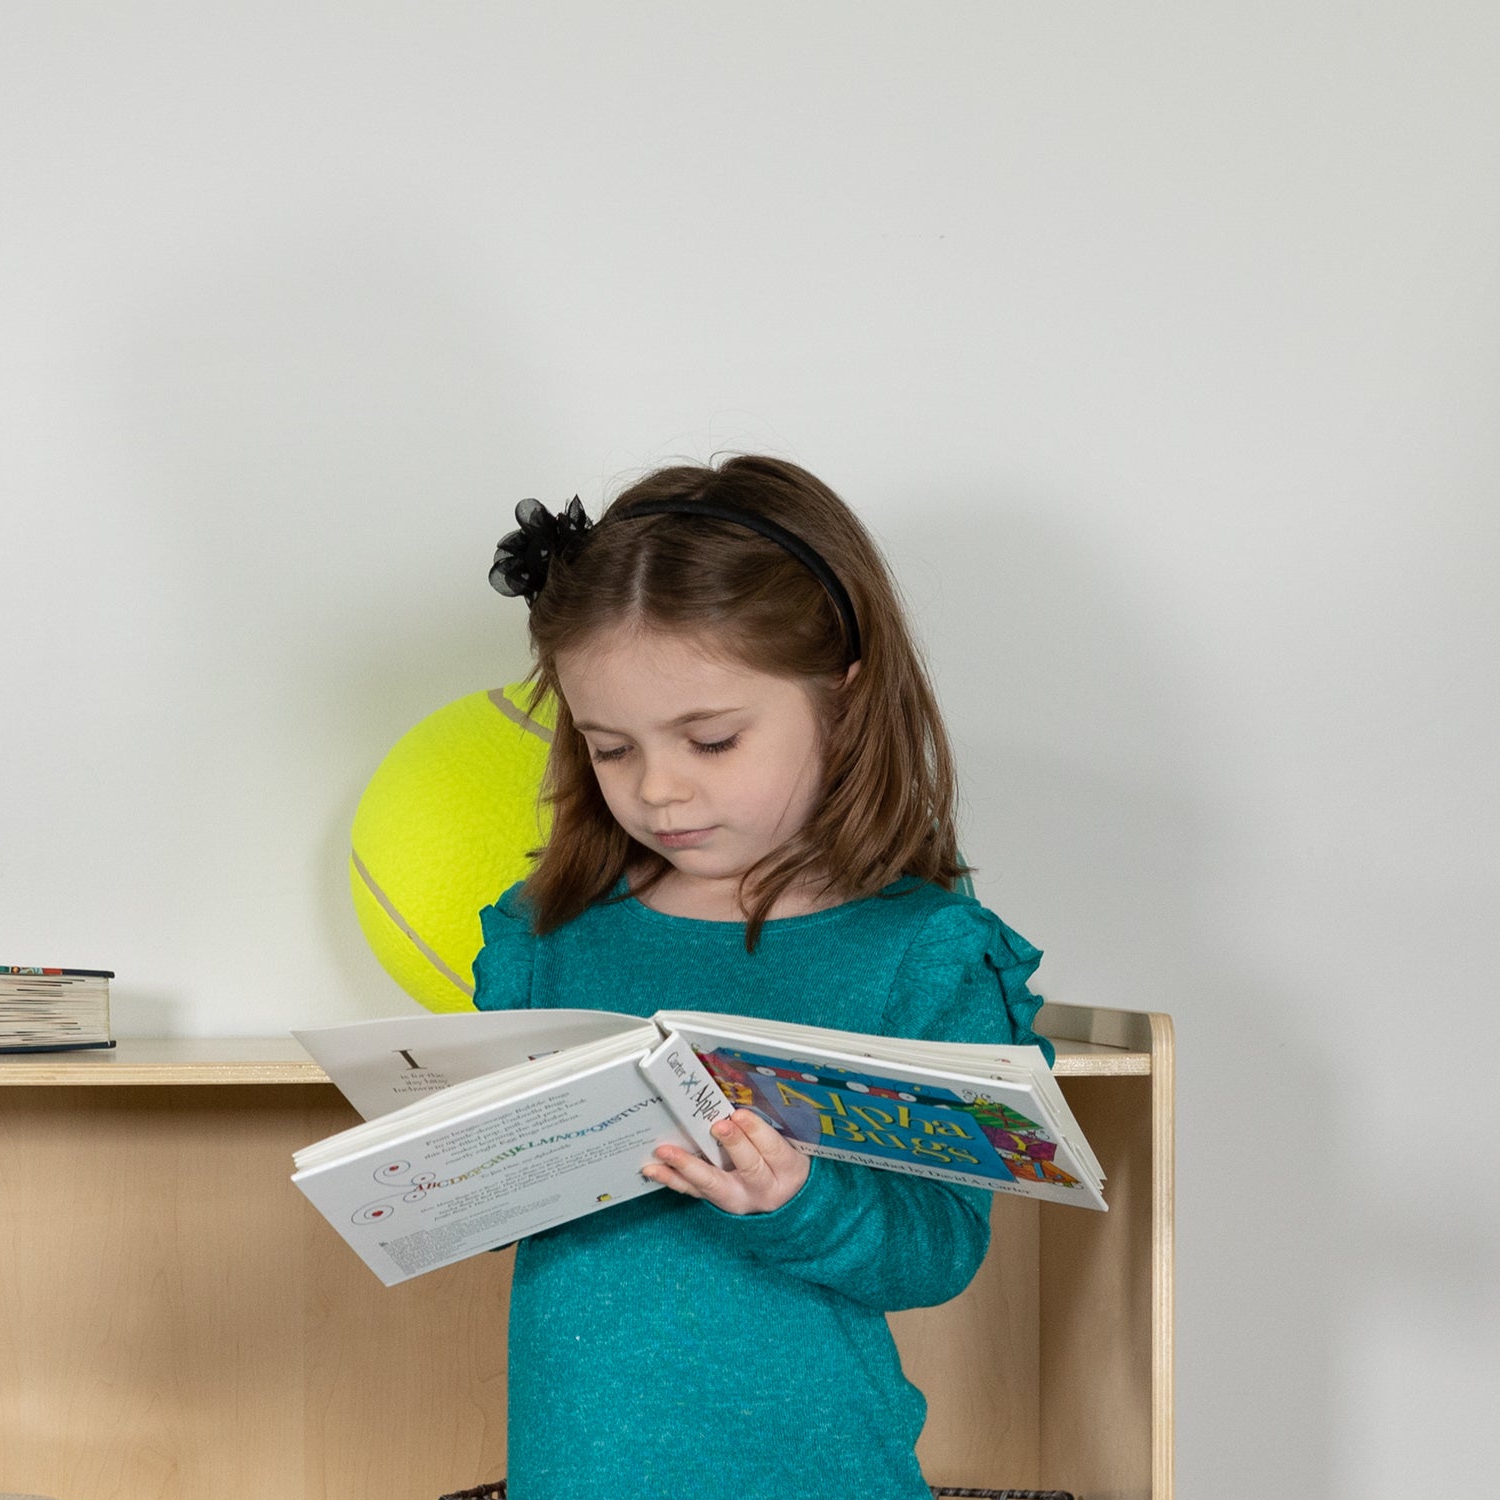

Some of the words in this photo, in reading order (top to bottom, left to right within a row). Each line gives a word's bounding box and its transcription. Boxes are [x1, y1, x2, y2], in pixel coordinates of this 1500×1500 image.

[391, 1048, 428, 1071] I
[666, 1051, 687, 1078] Carter
[689, 1083, 722, 1122] Alpha
[776, 1080, 975, 1141] Alpha
[814, 1112, 980, 1165] Bugs
